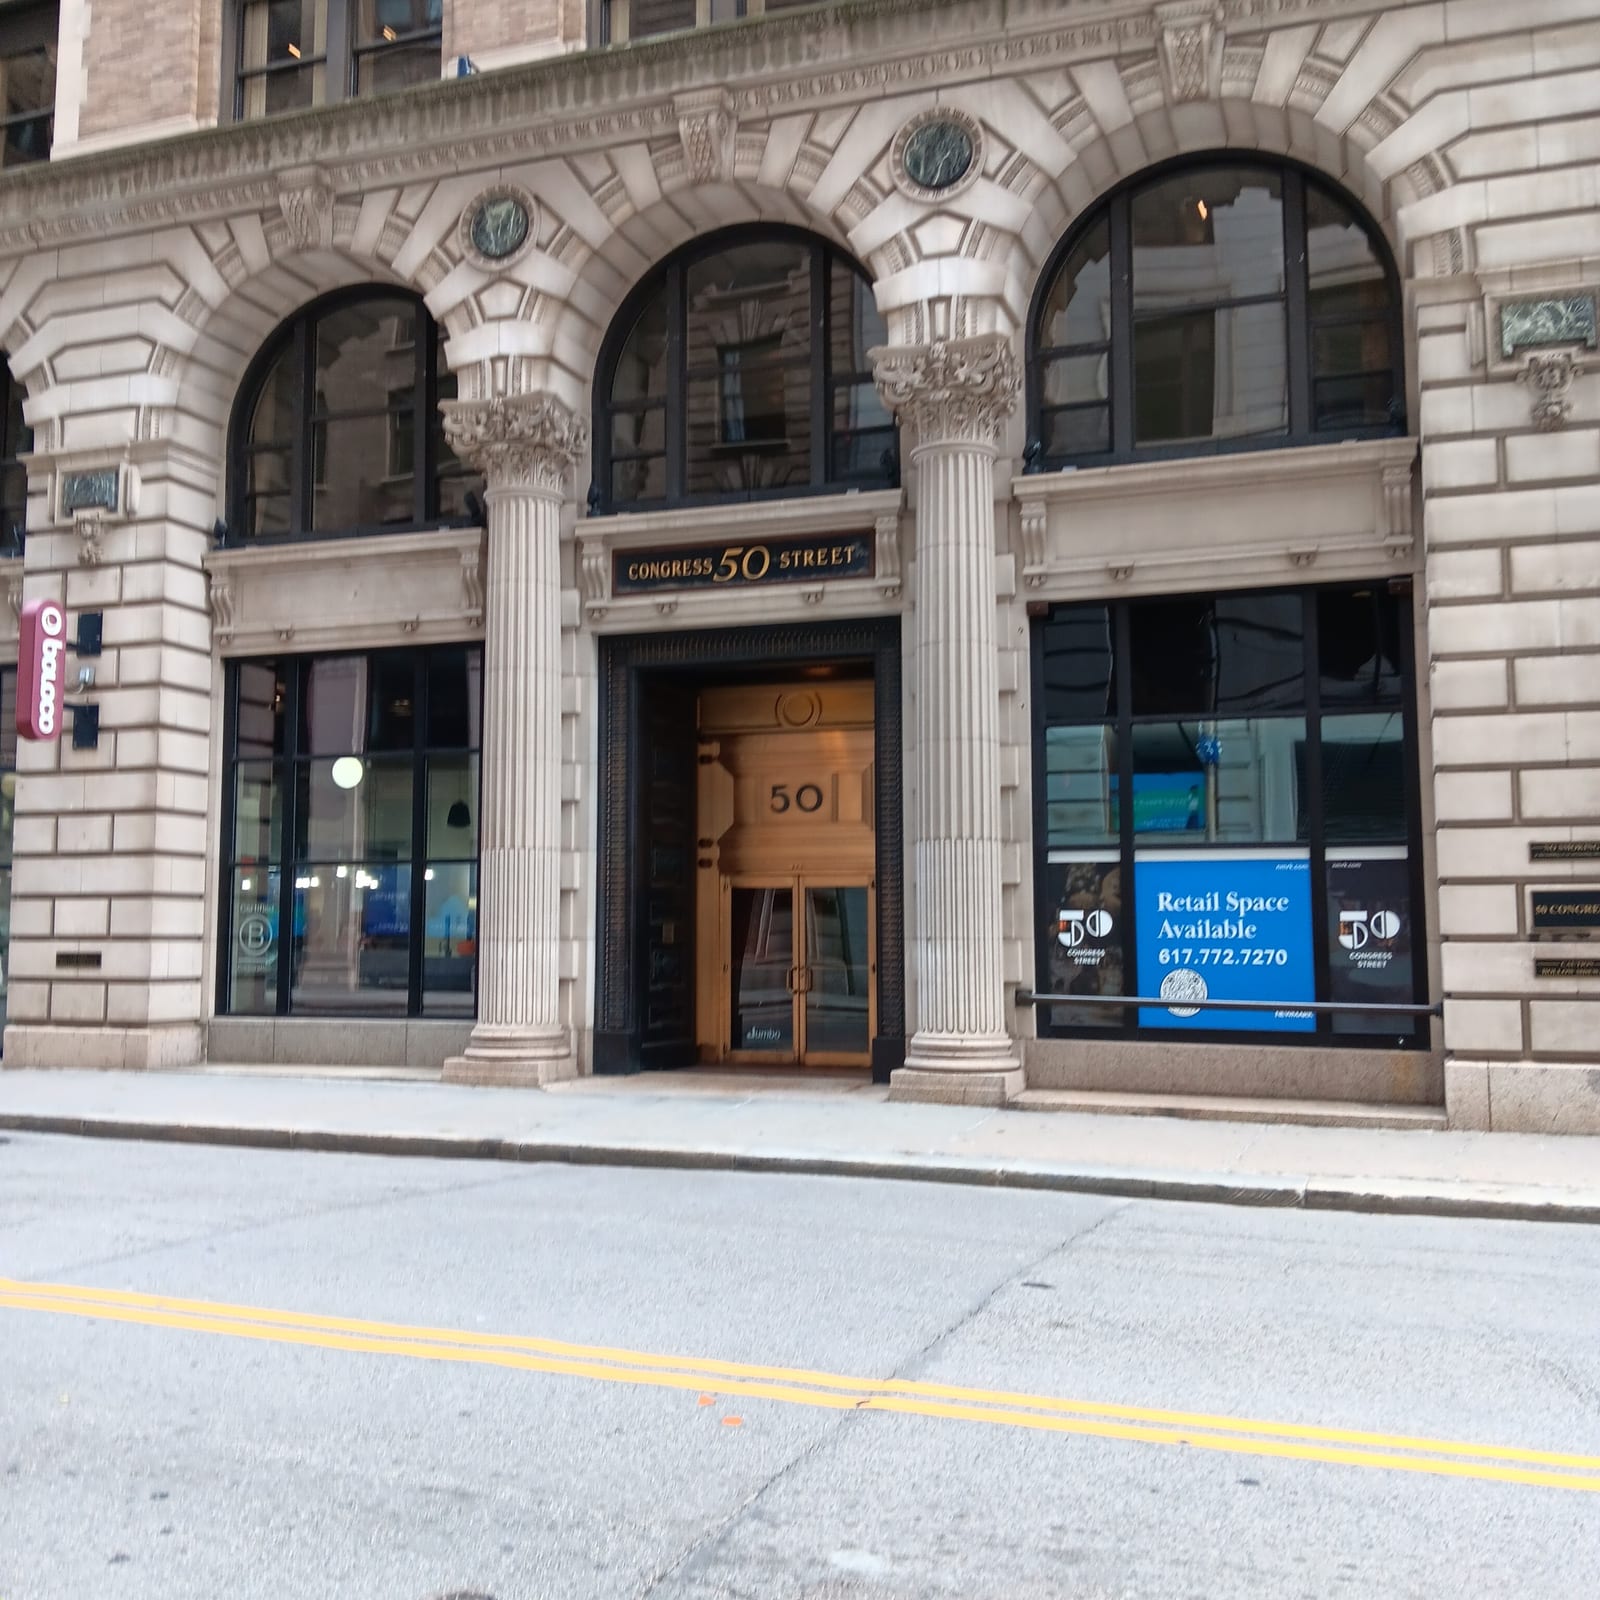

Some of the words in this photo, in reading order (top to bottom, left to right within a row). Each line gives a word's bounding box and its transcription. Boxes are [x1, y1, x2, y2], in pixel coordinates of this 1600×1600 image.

[628, 558, 713, 581] CONGRESS
[712, 545, 770, 582] 50
[780, 545, 855, 569] STREET
[770, 783, 823, 814] 50
[1157, 891, 1220, 912] Retail
[1225, 890, 1290, 918] Space
[1057, 909, 1113, 947] 50
[1156, 918, 1257, 939] Available
[1338, 910, 1400, 950] 50
[1158, 948, 1289, 966] 617.772.7270
